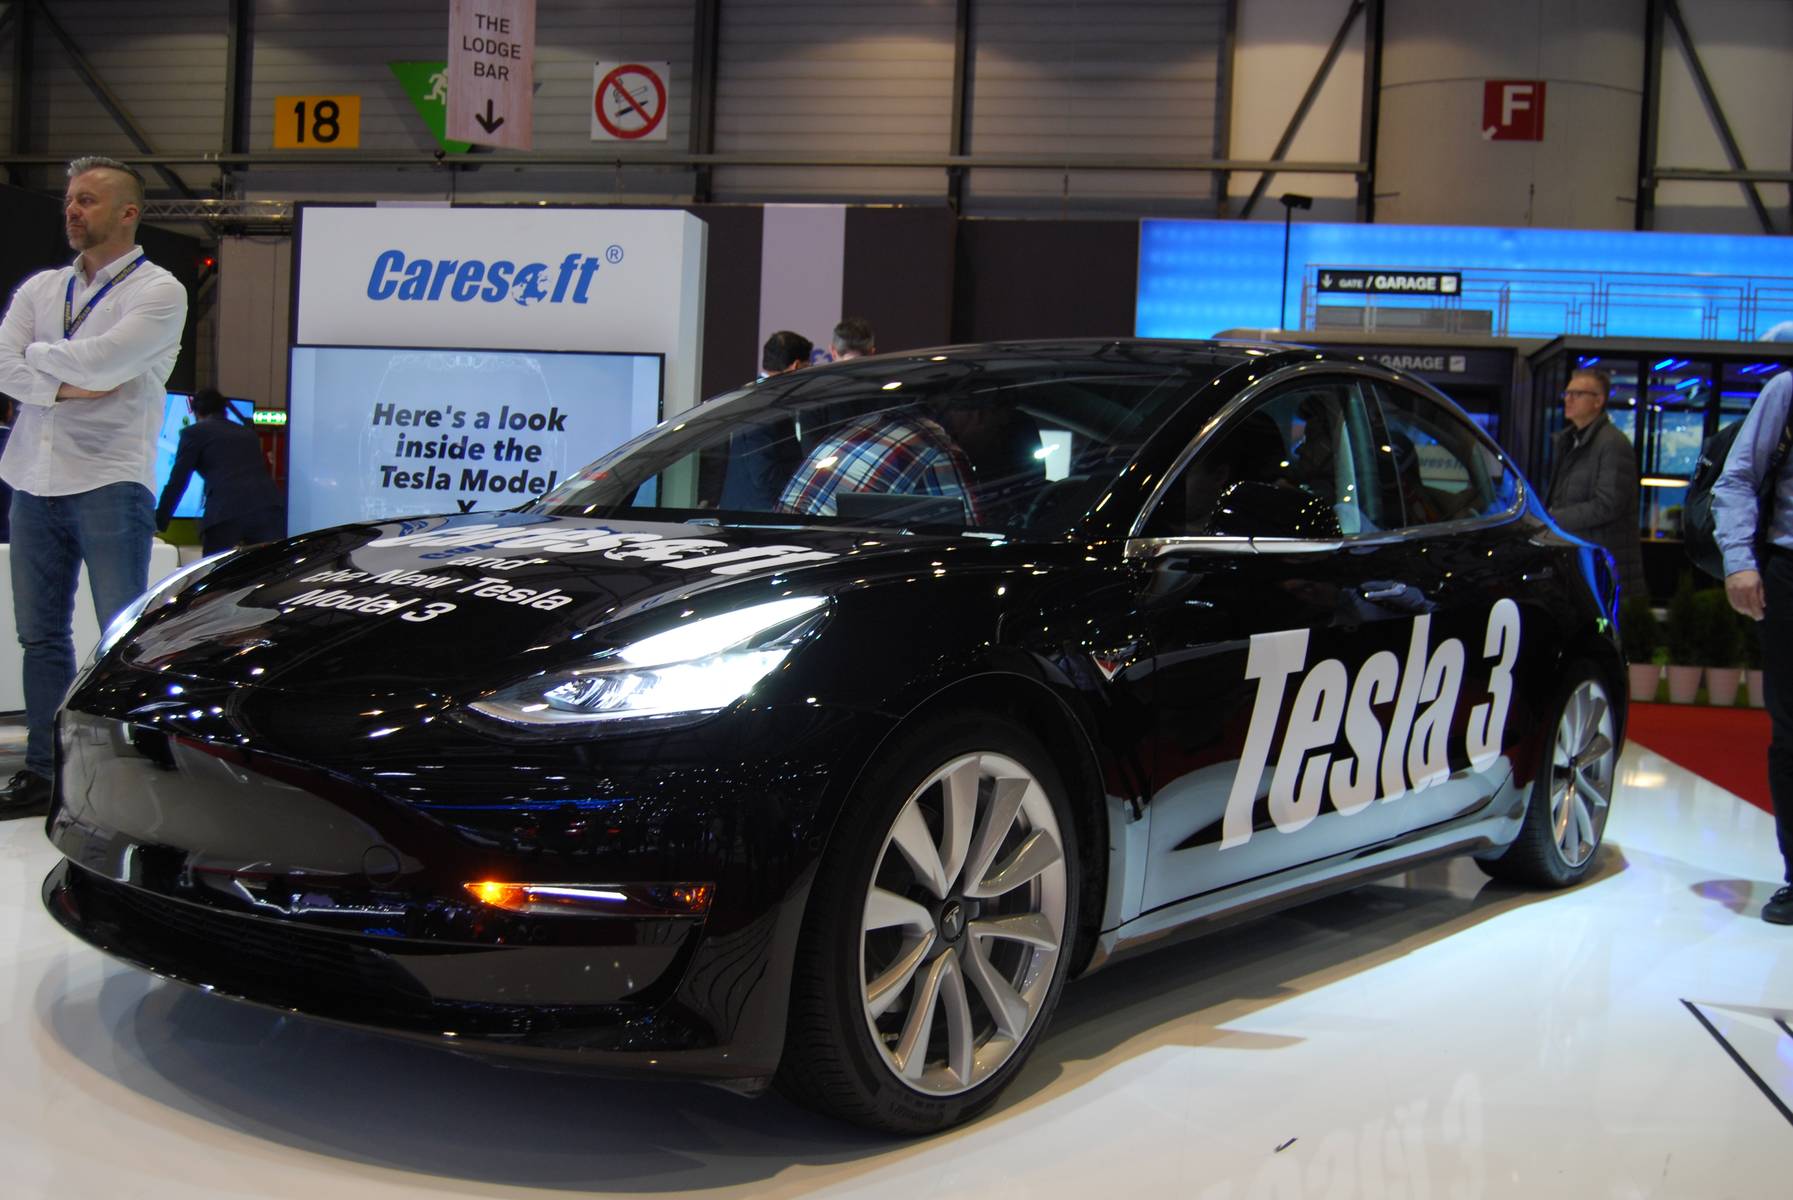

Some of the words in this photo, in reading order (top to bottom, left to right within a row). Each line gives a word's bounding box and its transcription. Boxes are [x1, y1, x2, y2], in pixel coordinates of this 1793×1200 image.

[475, 13, 511, 34] THE
[463, 35, 522, 60] LODGE
[473, 62, 509, 81] BAR
[1502, 85, 1533, 126] F
[294, 100, 340, 143] 18
[367, 249, 600, 306] Caresoft
[1338, 277, 1363, 289] GATE
[1374, 275, 1437, 291] GARAGE
[1379, 354, 1444, 371] GARAGE
[372, 402, 466, 428] Here's
[474, 410, 491, 430] a
[498, 405, 568, 432] look
[395, 432, 485, 461] inside
[494, 437, 542, 463] the
[380, 465, 451, 491] Tesla
[459, 468, 557, 495] Model
[446, 556, 540, 571] and
[300, 568, 368, 583] the
[359, 569, 463, 589] New
[456, 576, 573, 611] Tesla
[278, 589, 422, 615] Model
[400, 601, 458, 622] 3
[1219, 613, 1465, 850] Tesla
[1465, 597, 1521, 774] 3
